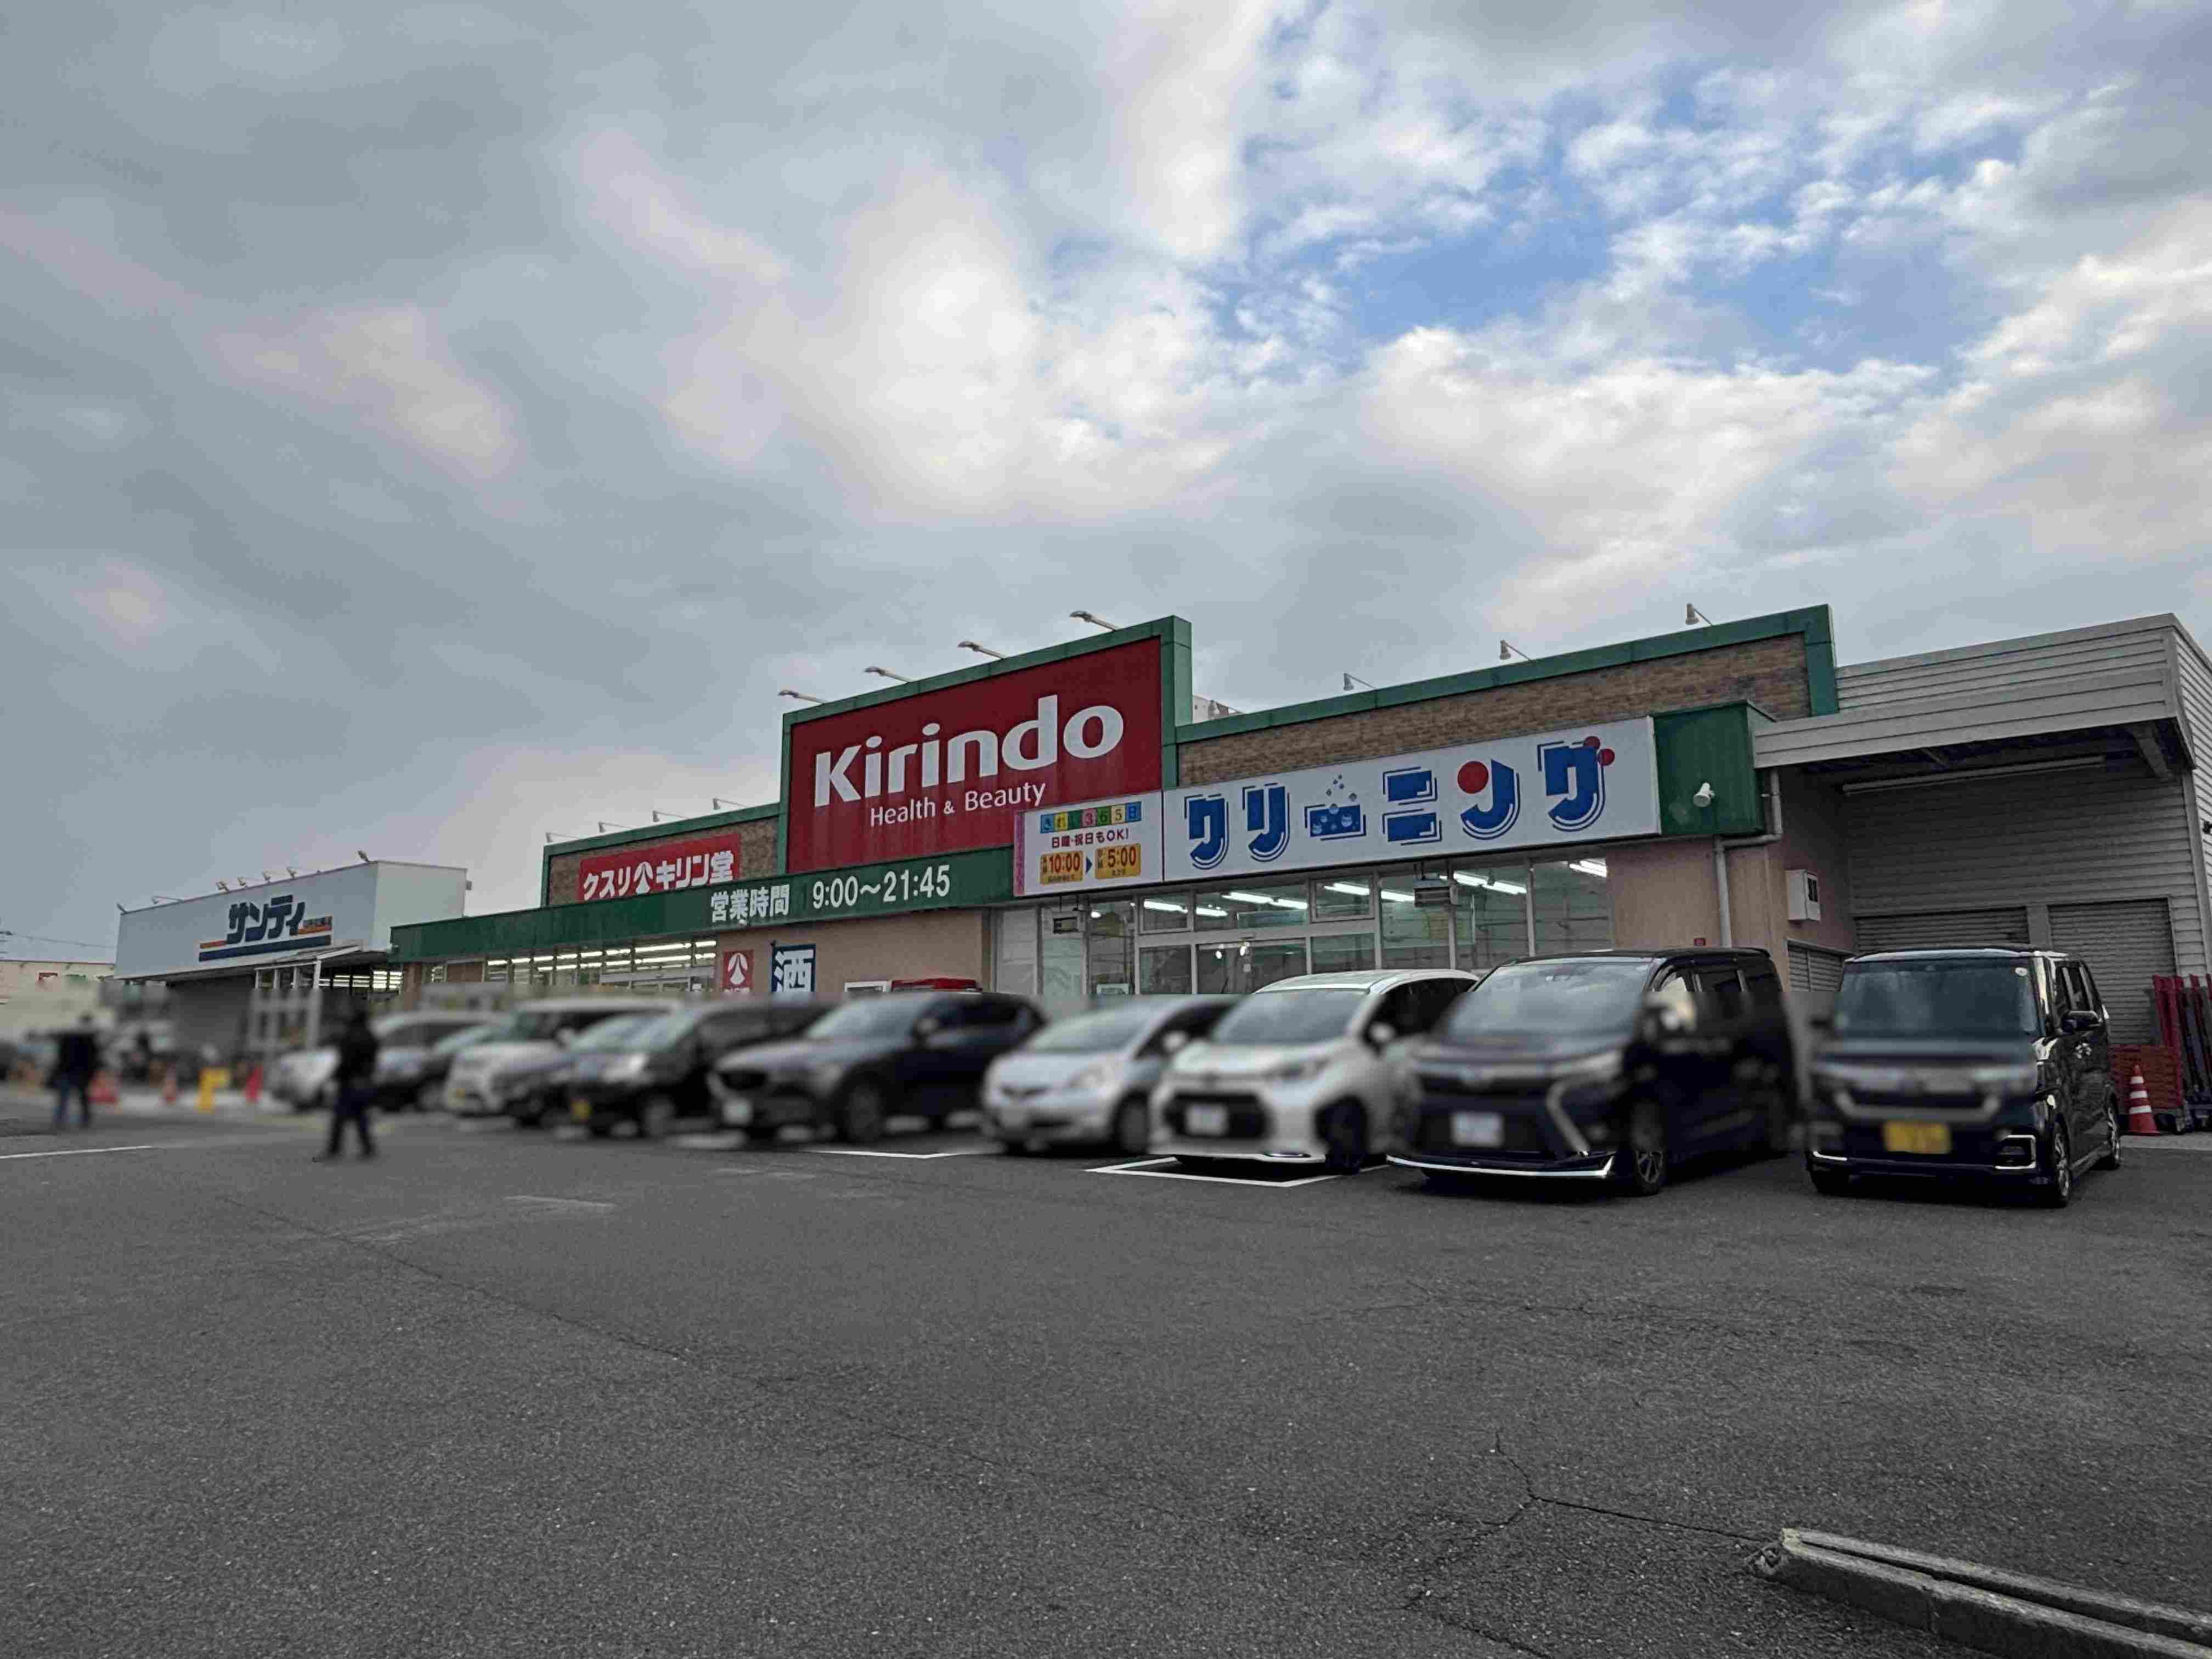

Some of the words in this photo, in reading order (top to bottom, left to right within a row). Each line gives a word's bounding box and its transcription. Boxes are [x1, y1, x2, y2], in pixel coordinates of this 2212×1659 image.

[814, 695, 1124, 807] Kirindo
[870, 798, 935, 827] Health
[943, 800, 955, 815] &
[964, 782, 1046, 812] Beauty
[1042, 804, 1140, 831] きれ365日
[1184, 736, 1616, 870] クリーニング
[584, 866, 630, 901] クスリ
[656, 850, 734, 890] キリン堂
[1049, 852, 1081, 873] 10:00
[1107, 845, 1137, 868] 5:00
[227, 894, 306, 945] サンディ
[712, 884, 790, 923] 営業時間
[774, 949, 814, 993] 酒
